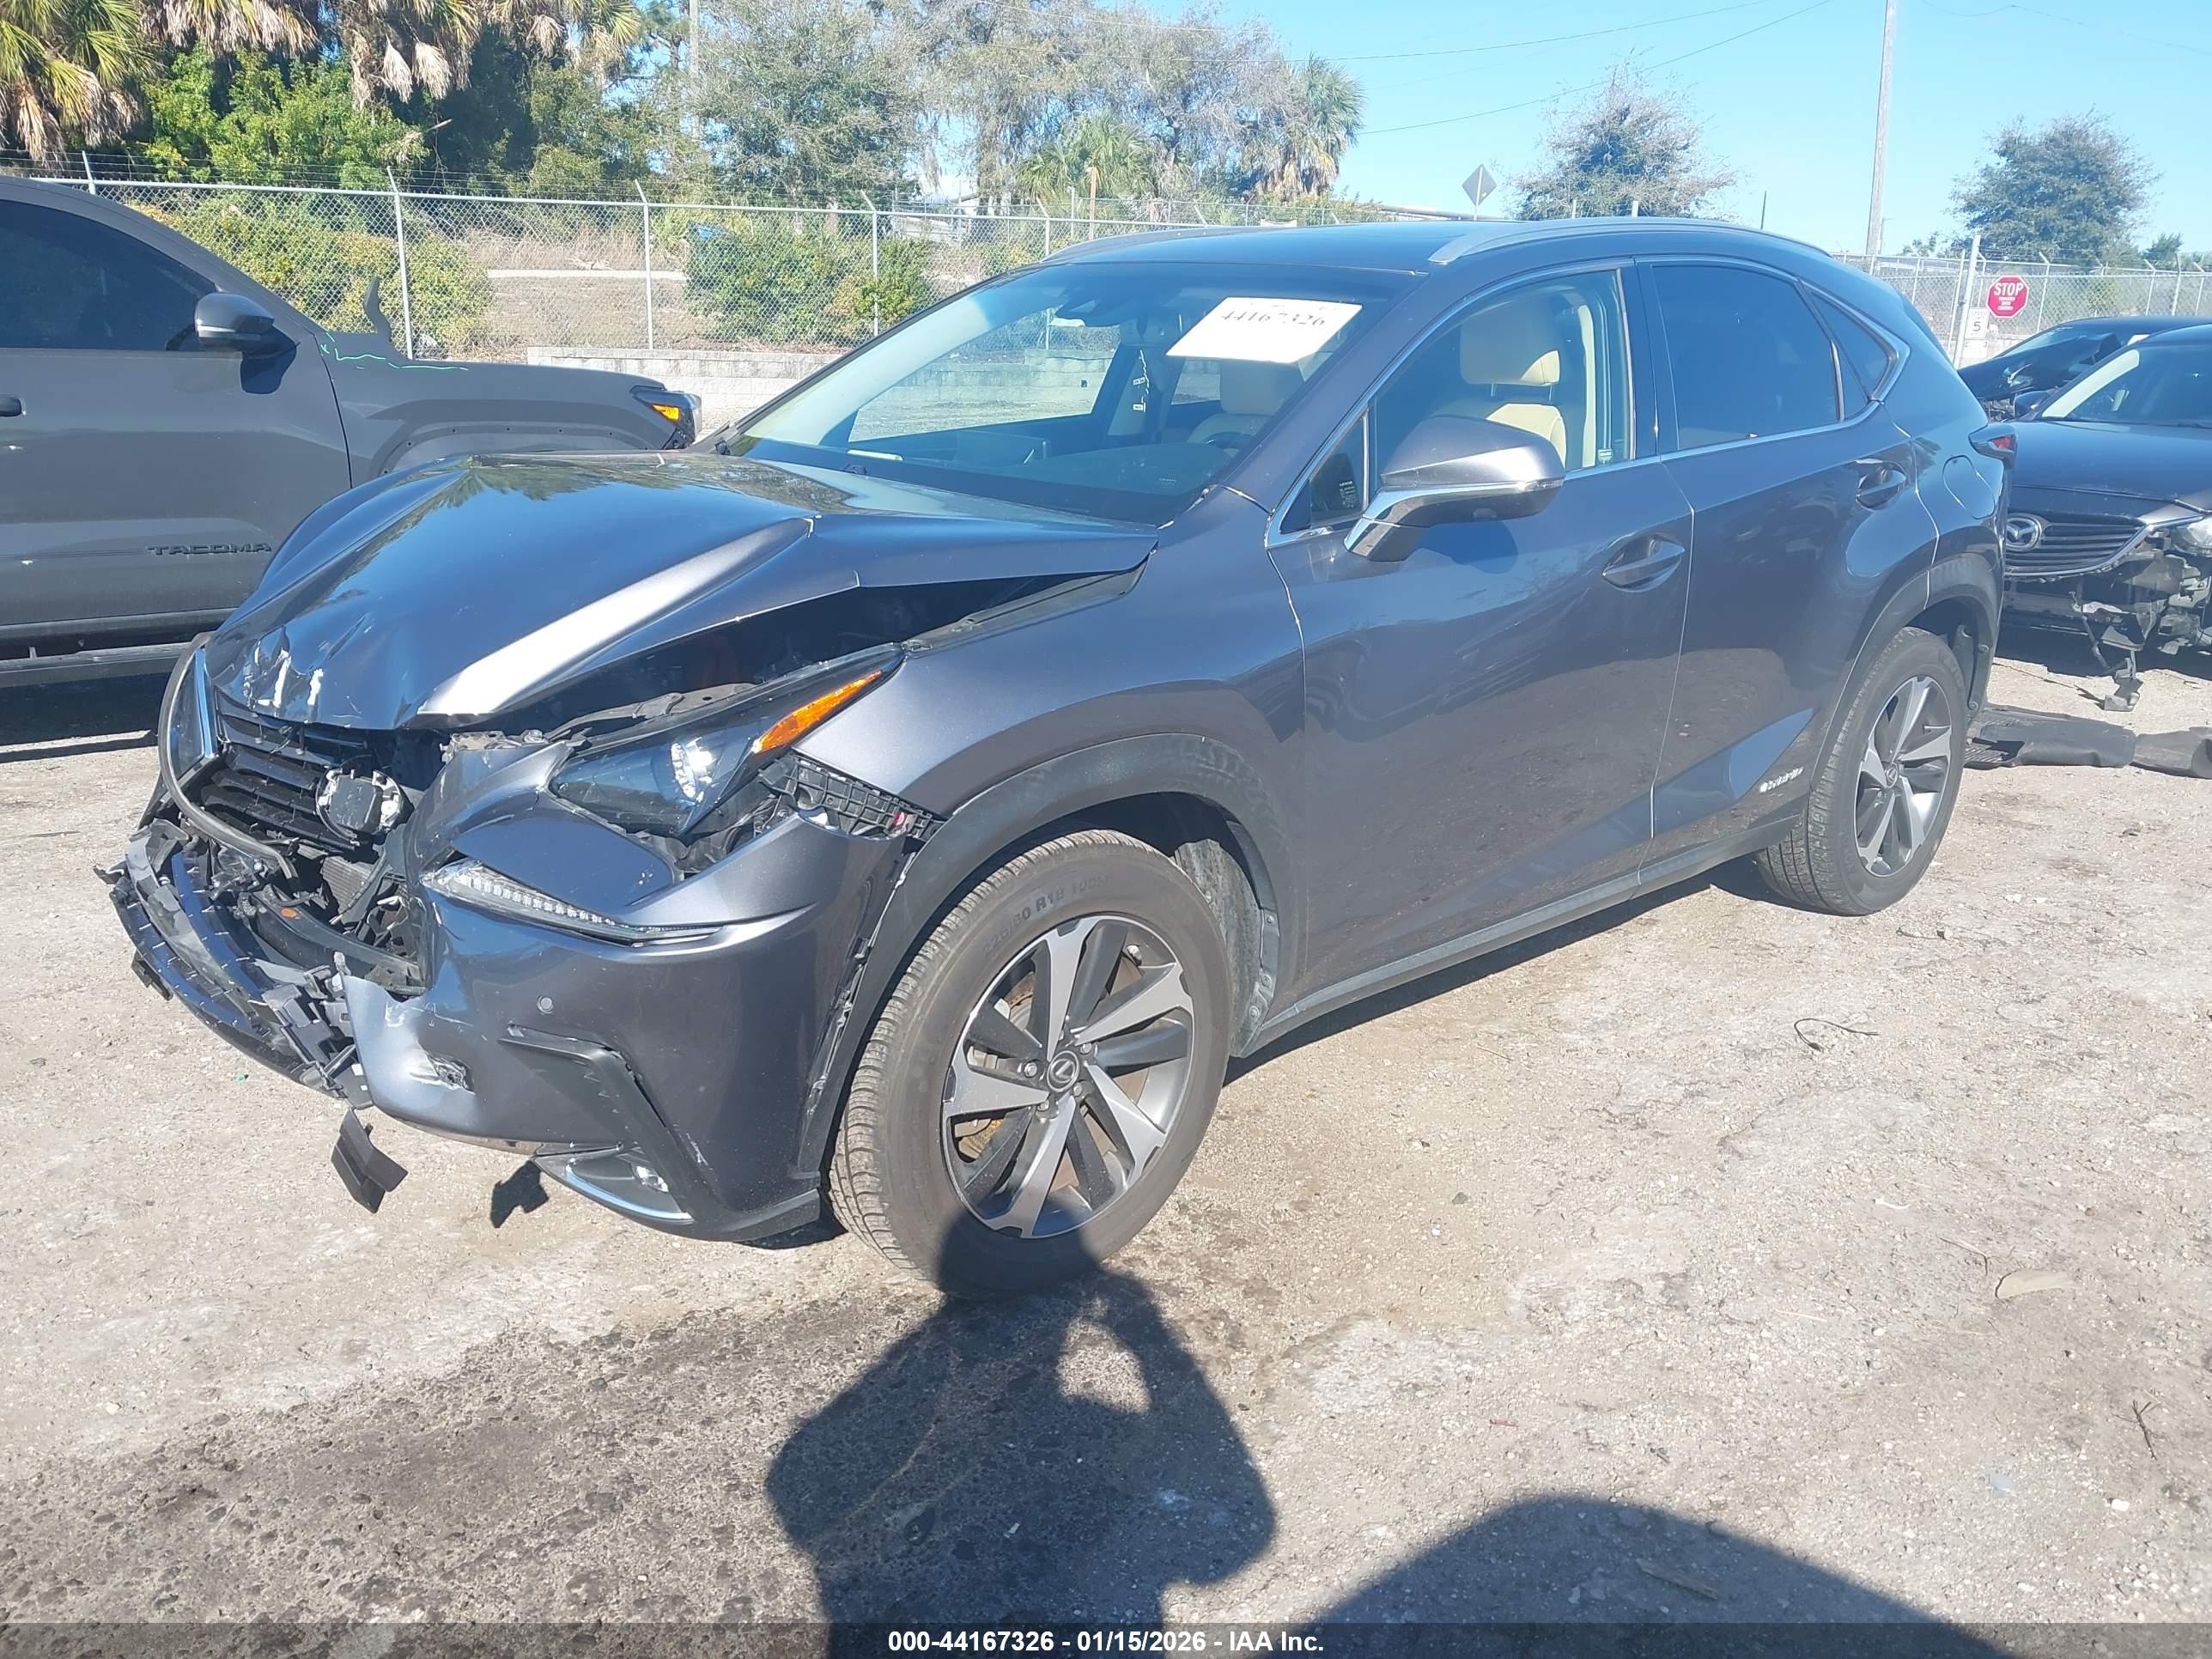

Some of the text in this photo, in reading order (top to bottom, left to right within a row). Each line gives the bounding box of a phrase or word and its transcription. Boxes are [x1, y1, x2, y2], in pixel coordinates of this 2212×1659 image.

[1993, 282, 2024, 296] STOP
[1972, 321, 1981, 331] 5
[147, 544, 271, 556] TACOMA
